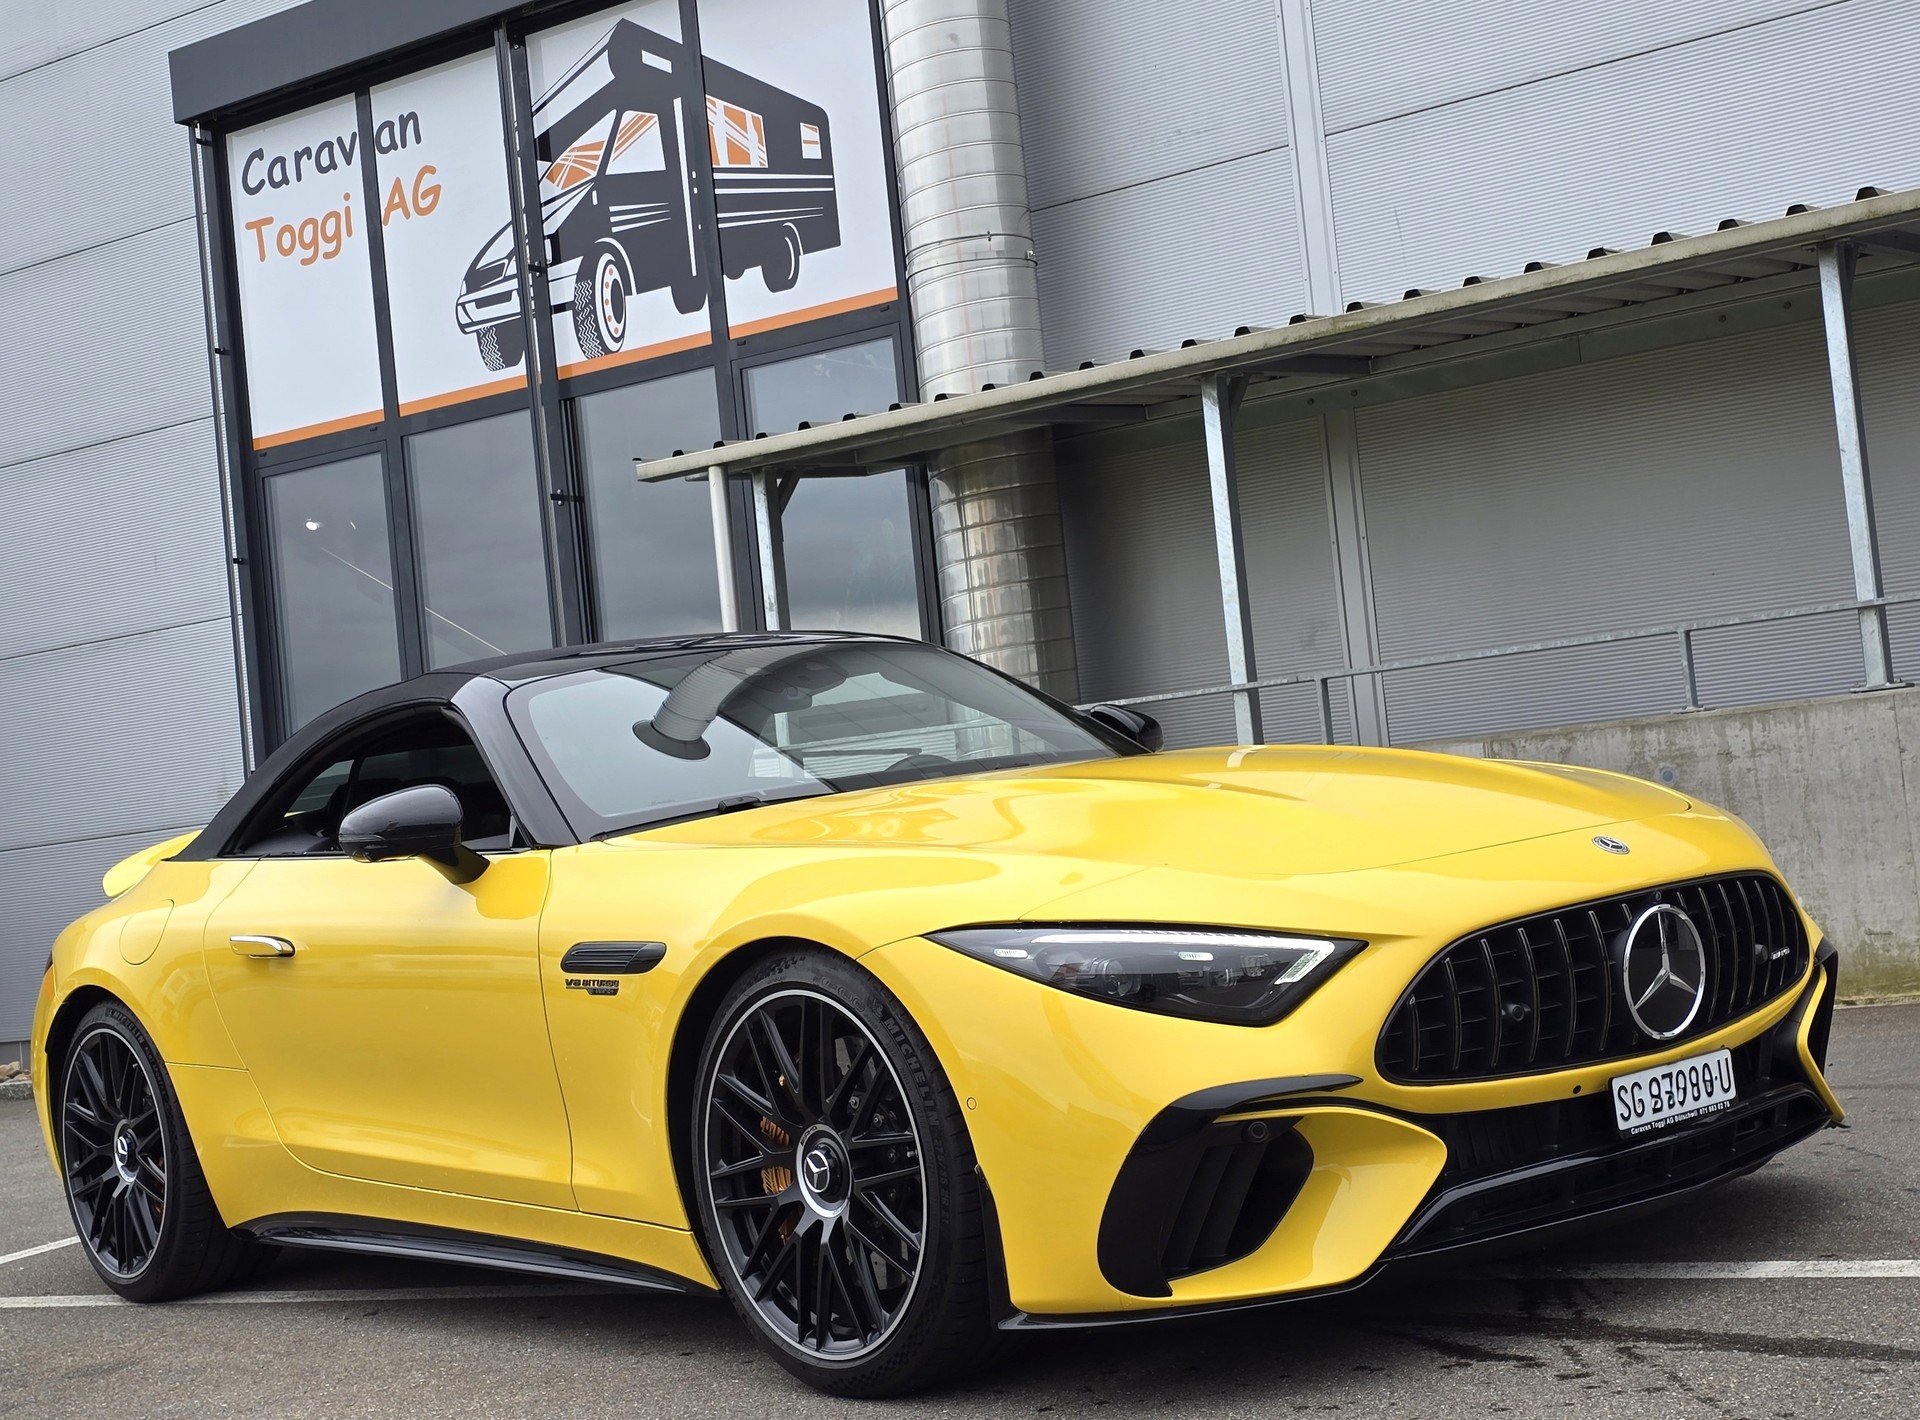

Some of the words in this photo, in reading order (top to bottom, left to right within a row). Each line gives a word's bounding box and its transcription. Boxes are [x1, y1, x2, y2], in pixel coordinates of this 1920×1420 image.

[242, 111, 422, 195] Caravan
[245, 192, 352, 266] Toggi
[383, 165, 441, 226] AG
[884, 1017, 940, 1126] MICHELIN
[1617, 1081, 1645, 1121] SG
[1630, 1124, 1652, 1135] Caravan
[1651, 1119, 1666, 1129] Toggi
[1666, 1116, 1674, 1125] AG
